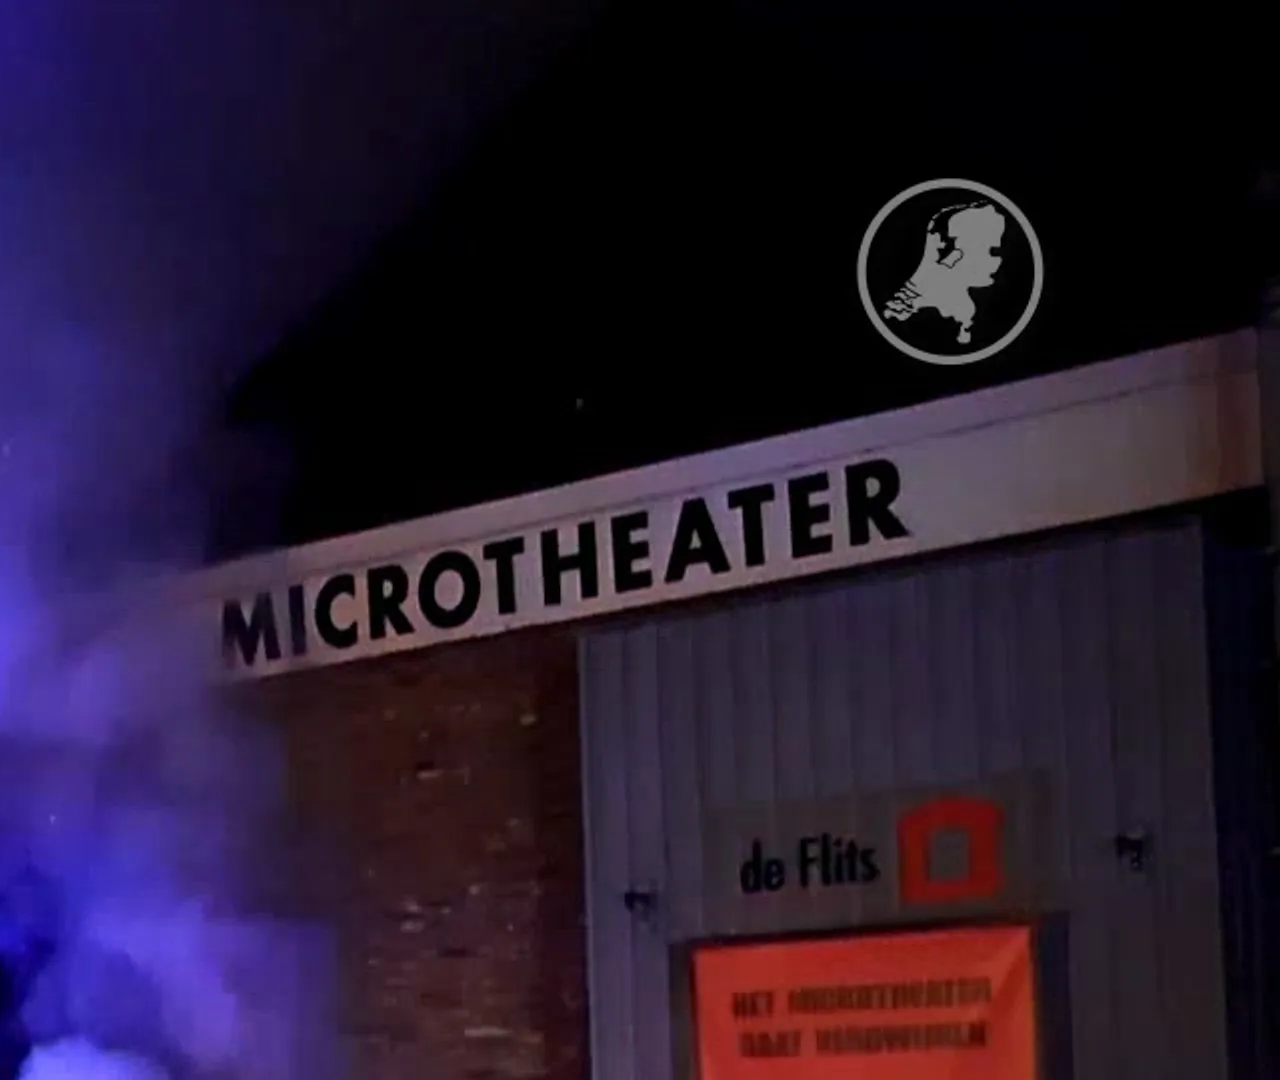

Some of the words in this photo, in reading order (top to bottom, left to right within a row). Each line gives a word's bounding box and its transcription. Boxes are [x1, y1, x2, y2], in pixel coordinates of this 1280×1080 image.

[224, 461, 909, 667] MICROTHEATER
[741, 838, 785, 892] de
[799, 833, 881, 889] Flits
